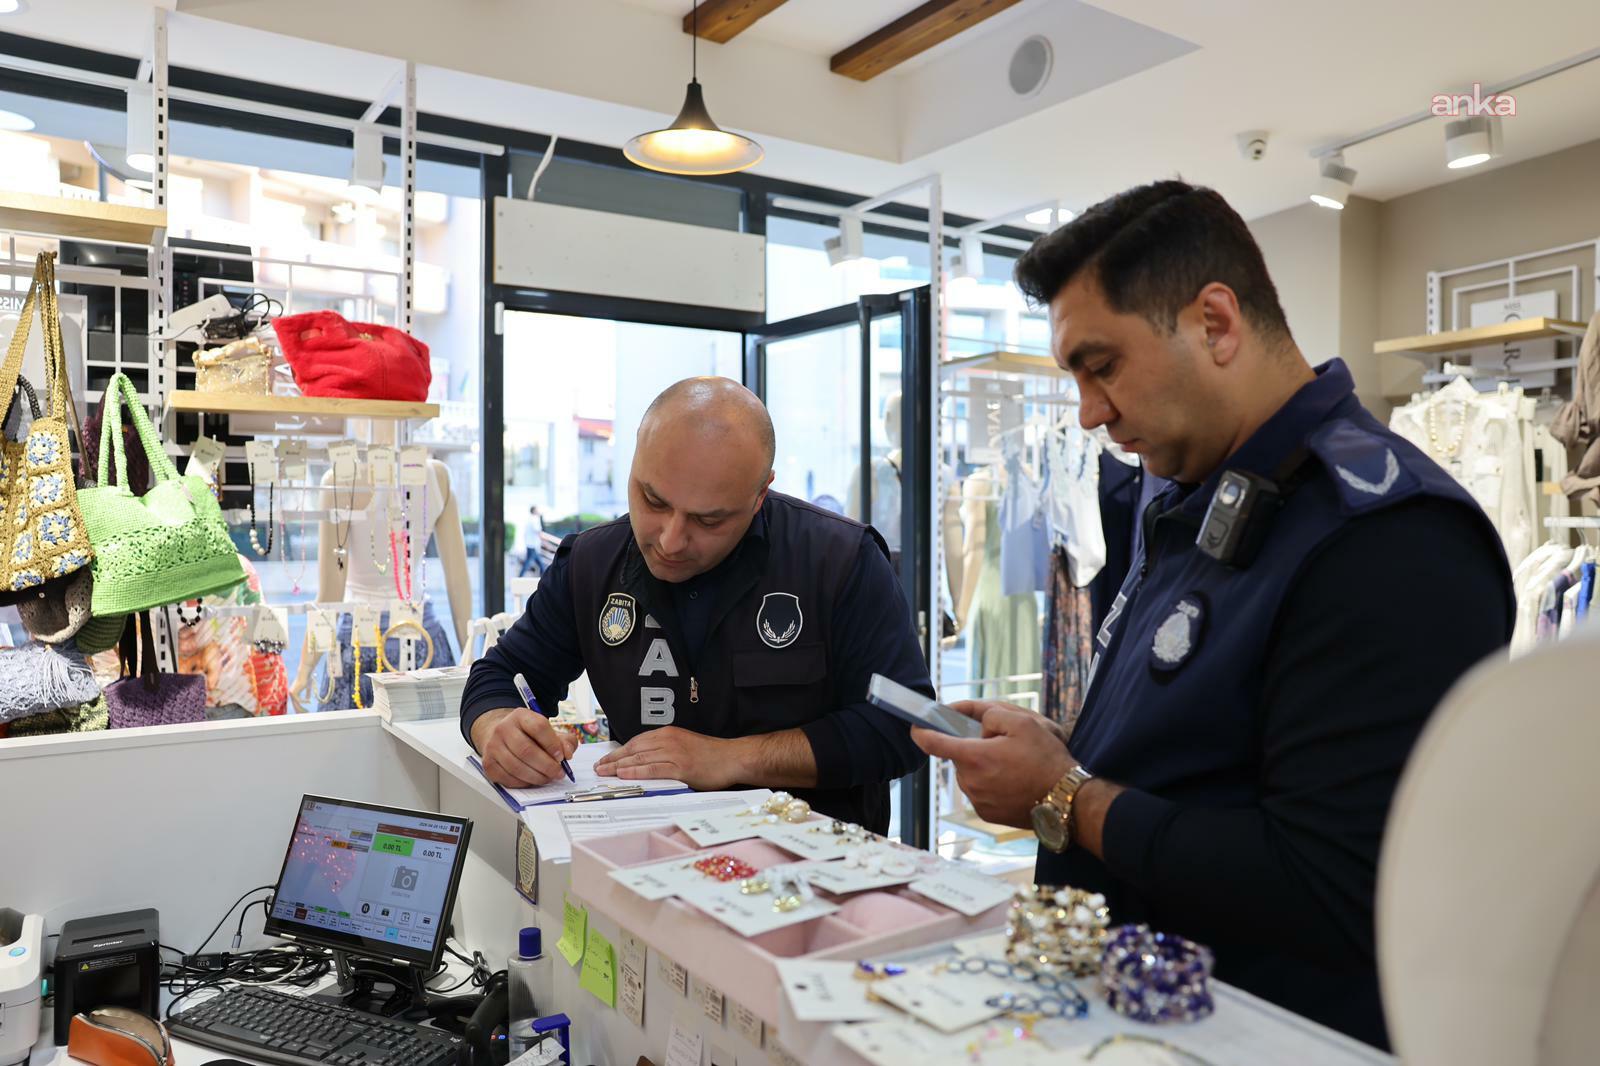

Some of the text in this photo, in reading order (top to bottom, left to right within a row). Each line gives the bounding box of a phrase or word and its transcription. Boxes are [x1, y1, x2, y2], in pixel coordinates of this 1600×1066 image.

[610, 597, 632, 607] ZABITA
[422, 850, 443, 859] 0.00 TL
